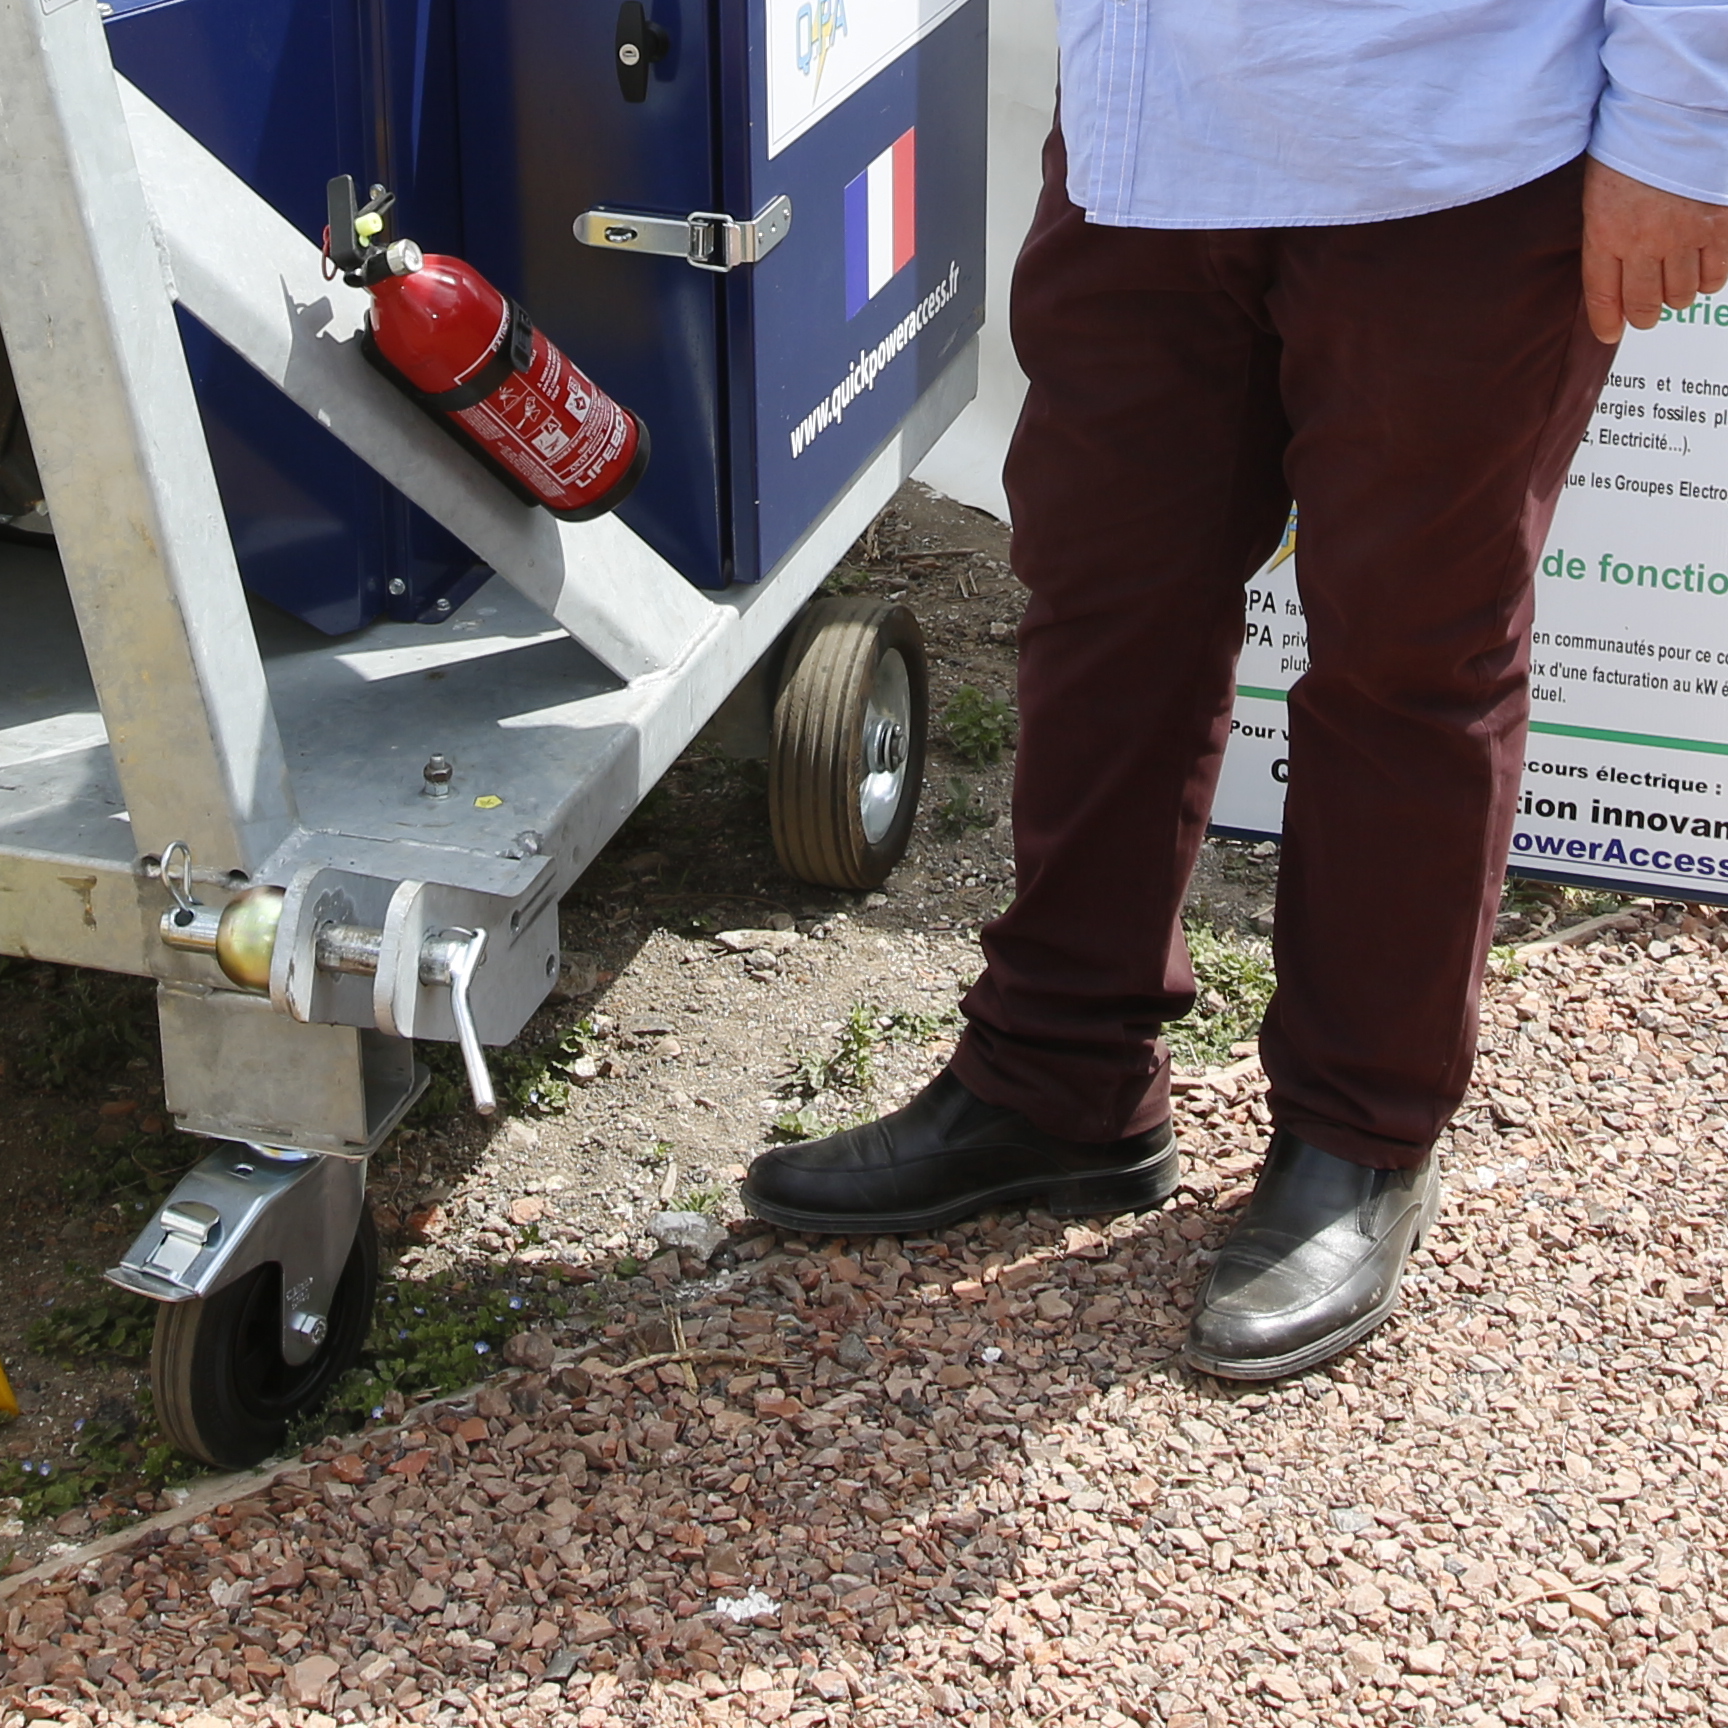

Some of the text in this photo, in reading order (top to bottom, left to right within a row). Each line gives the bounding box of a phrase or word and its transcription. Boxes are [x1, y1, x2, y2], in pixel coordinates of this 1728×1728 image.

[790, 259, 960, 459] www.quickpoweraccess.fr
[1657, 377, 1671, 393] et
[1653, 403, 1706, 424] fossiles
[1590, 471, 1611, 490] les
[1614, 474, 1674, 497] Groupes
[1542, 548, 1586, 580] de
[1554, 630, 1656, 658] communautés
[1658, 643, 1689, 664] pour
[1692, 647, 1713, 664] ce
[1551, 660, 1589, 681] d'une
[1592, 665, 1669, 692] facturation
[1673, 677, 1692, 693] au
[1695, 676, 1720, 696] kW
[1531, 686, 1567, 705] duel.
[1596, 765, 1709, 797] électrique
